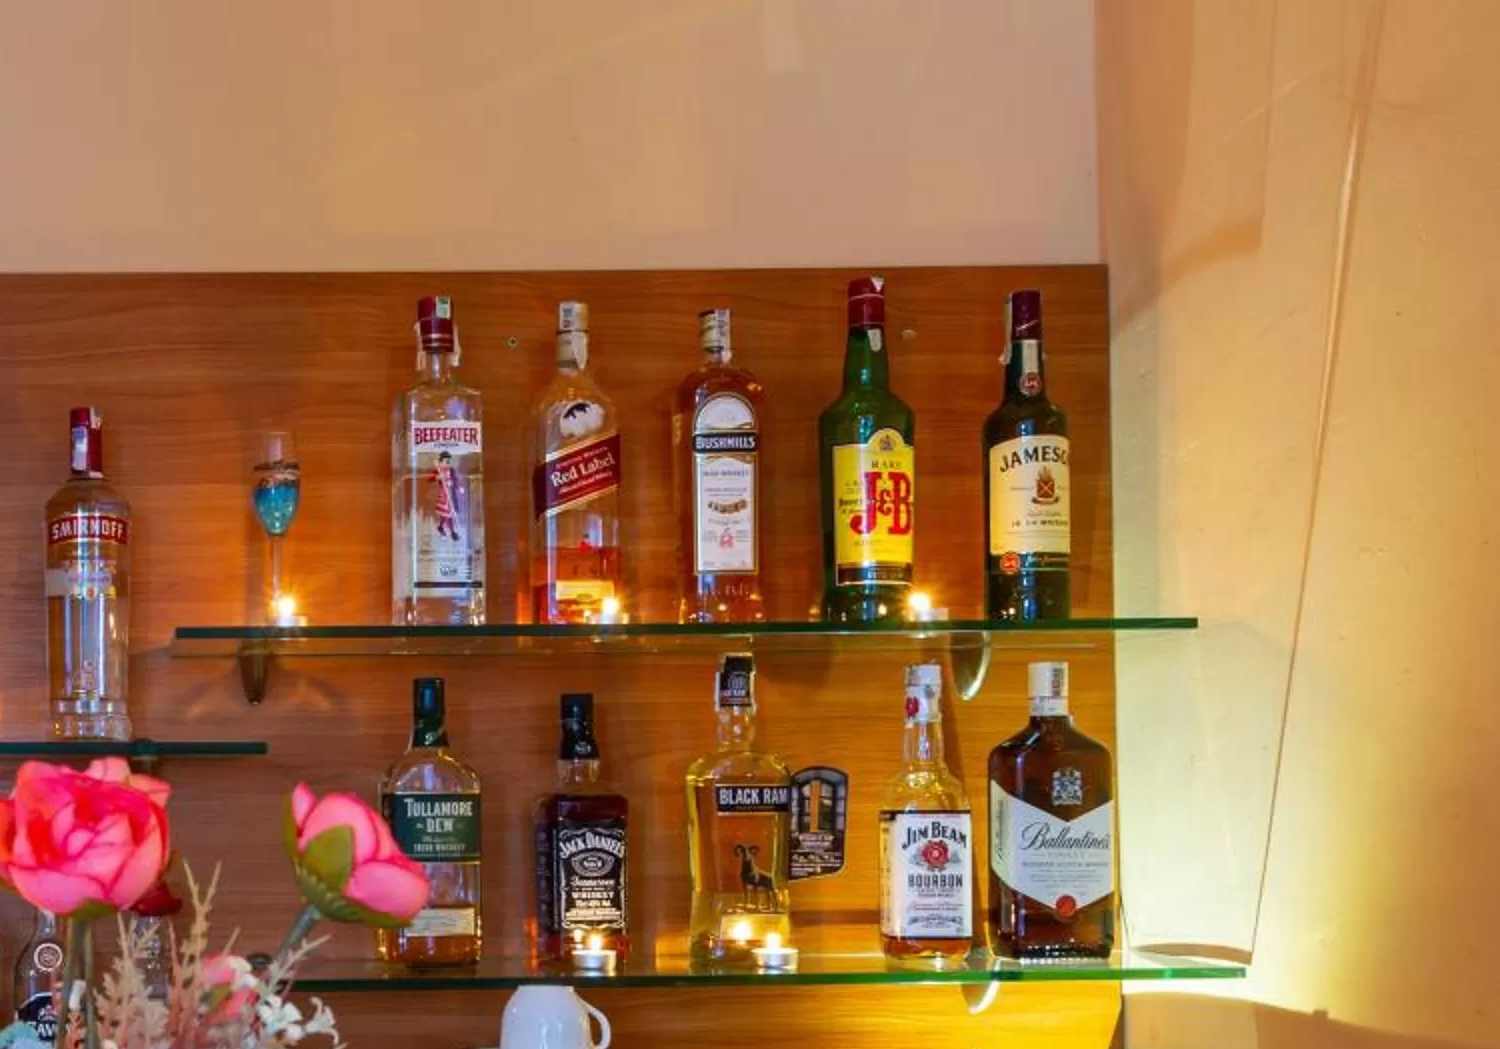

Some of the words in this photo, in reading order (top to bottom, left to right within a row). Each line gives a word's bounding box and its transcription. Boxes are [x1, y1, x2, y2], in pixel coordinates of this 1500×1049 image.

[414, 427, 479, 446] BEEFEATER
[695, 436, 756, 450] BUSHMILLS
[550, 467, 578, 488] Red
[580, 450, 617, 475] Label
[51, 518, 125, 541] SMIRNOFF
[719, 787, 759, 805] BLACK
[763, 787, 788, 805] RAM
[403, 797, 474, 818] TULLAMORE
[426, 817, 454, 833] DEW
[902, 826, 929, 849] JIM
[932, 821, 967, 849] BEAM
[908, 874, 963, 889] BOURBON
